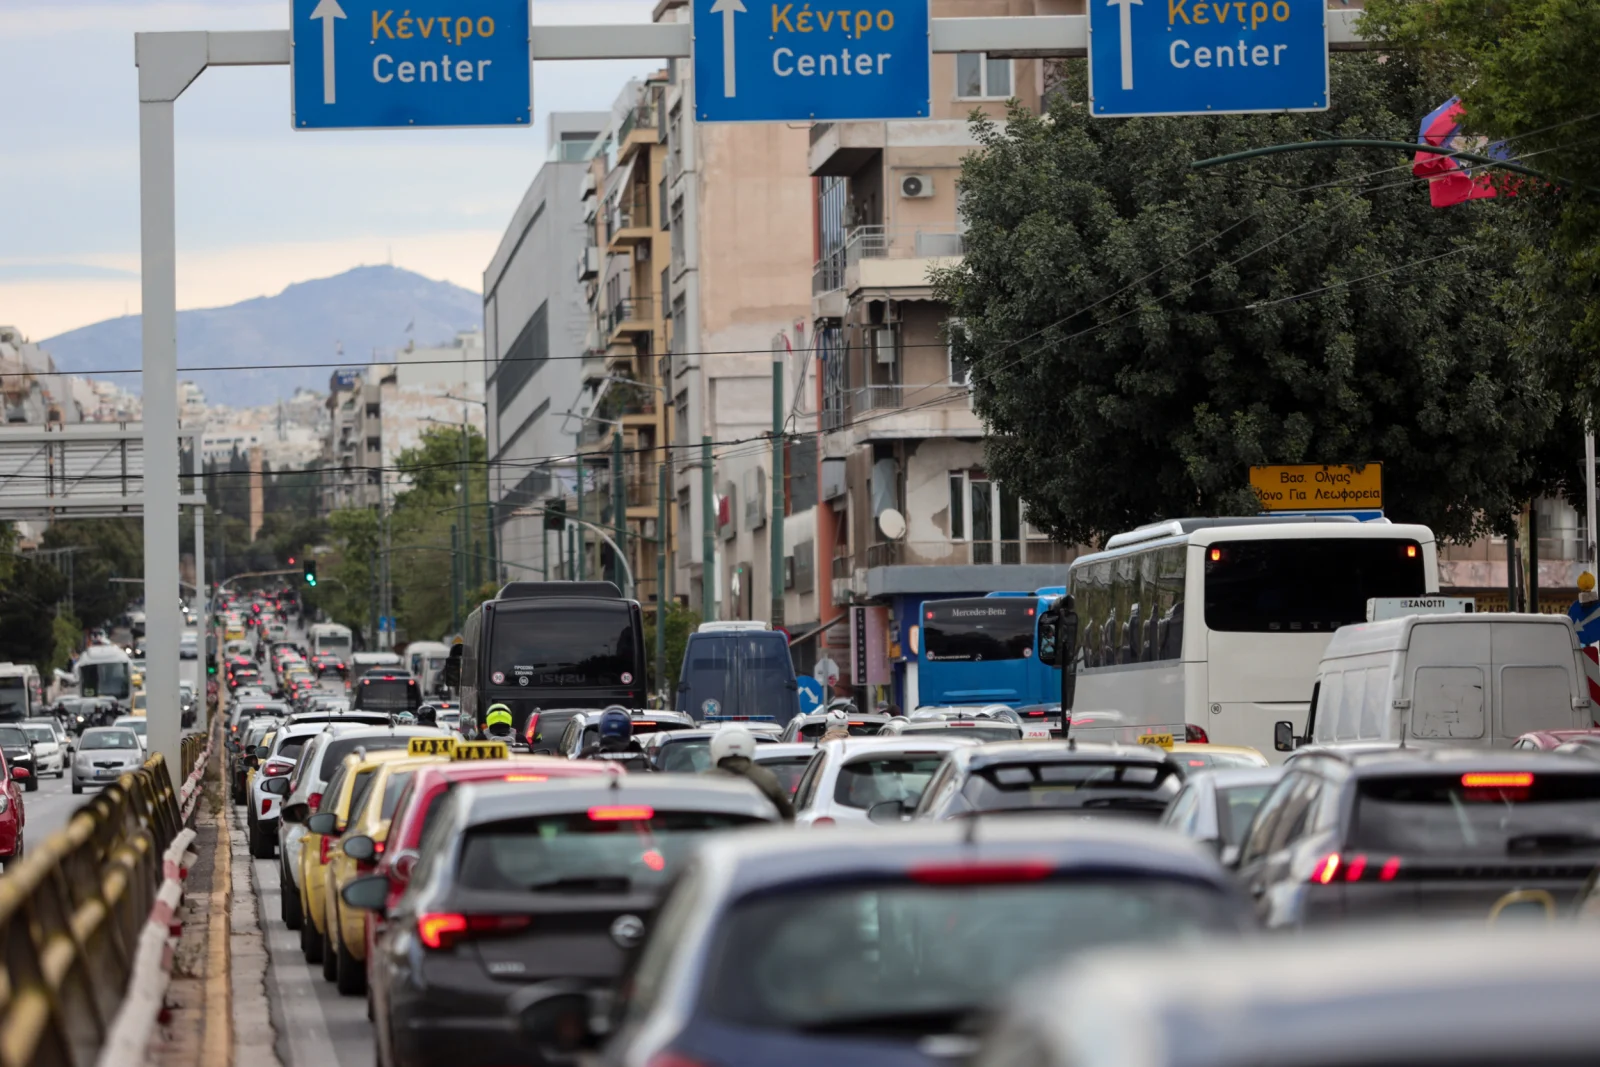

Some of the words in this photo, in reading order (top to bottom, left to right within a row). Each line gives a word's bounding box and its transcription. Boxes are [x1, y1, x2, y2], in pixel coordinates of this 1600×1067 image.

[372, 9, 495, 46] Κέντρο
[772, 3, 894, 39] Κέντρο
[1169, 39, 1288, 69] Center
[373, 53, 492, 83] Center
[773, 47, 892, 77] Center
[1280, 472, 1307, 483] Βασ.
[1289, 488, 1307, 500] Για
[1315, 487, 1381, 502] Λεωφορεία
[1408, 600, 1445, 608] ZANOTTI
[952, 607, 1007, 617] Mercedes-Benz
[414, 740, 453, 753] TAXI
[1141, 735, 1170, 745] TAXI
[459, 747, 501, 759] TAXI
